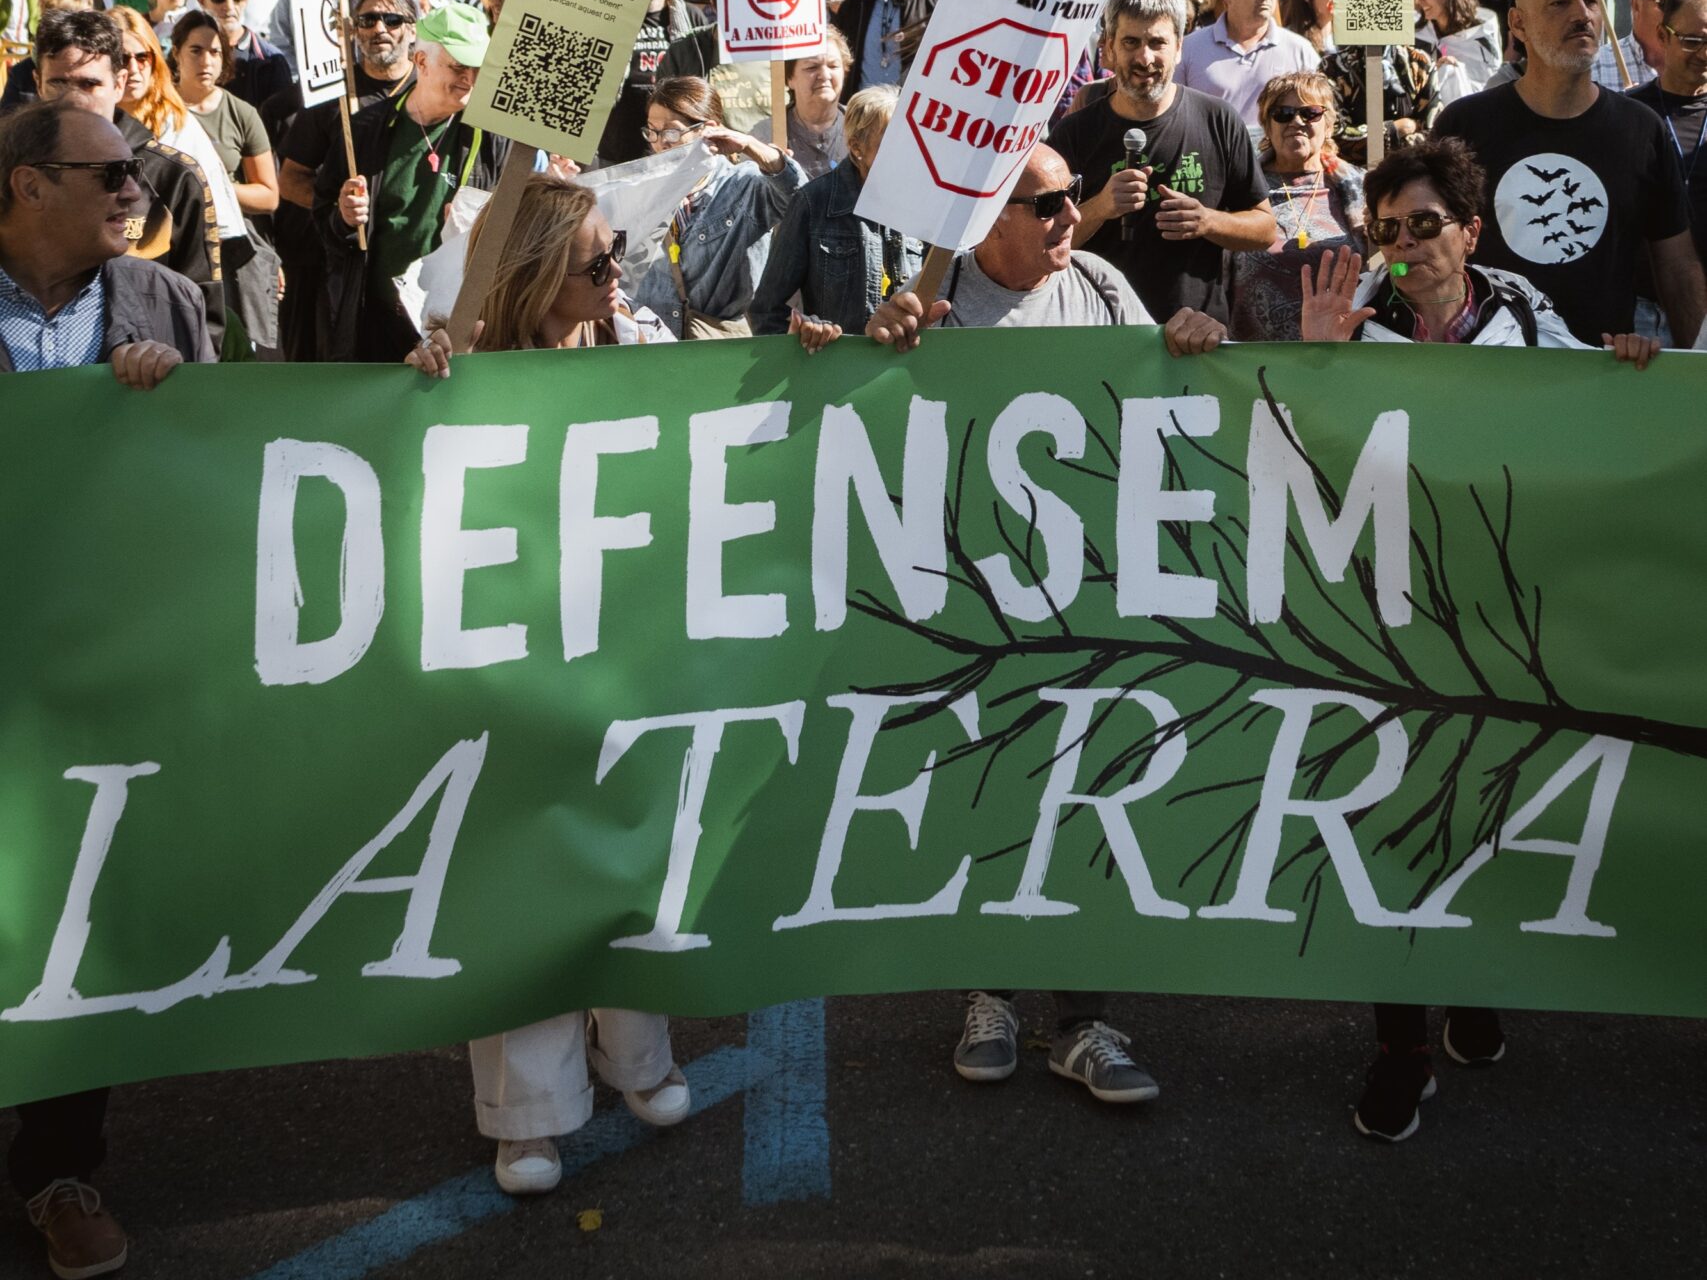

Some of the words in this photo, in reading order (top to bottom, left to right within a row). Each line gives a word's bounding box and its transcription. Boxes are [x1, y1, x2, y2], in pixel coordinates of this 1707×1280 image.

[578, 3, 602, 18] aquest
[604, 12, 616, 23] QR
[1051, 0, 1099, 19] PLANTA
[731, 28, 740, 41] A
[745, 23, 818, 41] ANGLESOLA
[313, 64, 320, 80] A
[322, 59, 341, 75] VIL
[950, 48, 1061, 104] STOP
[919, 98, 1042, 153] BIOGAS
[254, 394, 1410, 686] DEFENSEM
[0, 729, 489, 1022] LA
[596, 687, 1634, 953] TERRA
